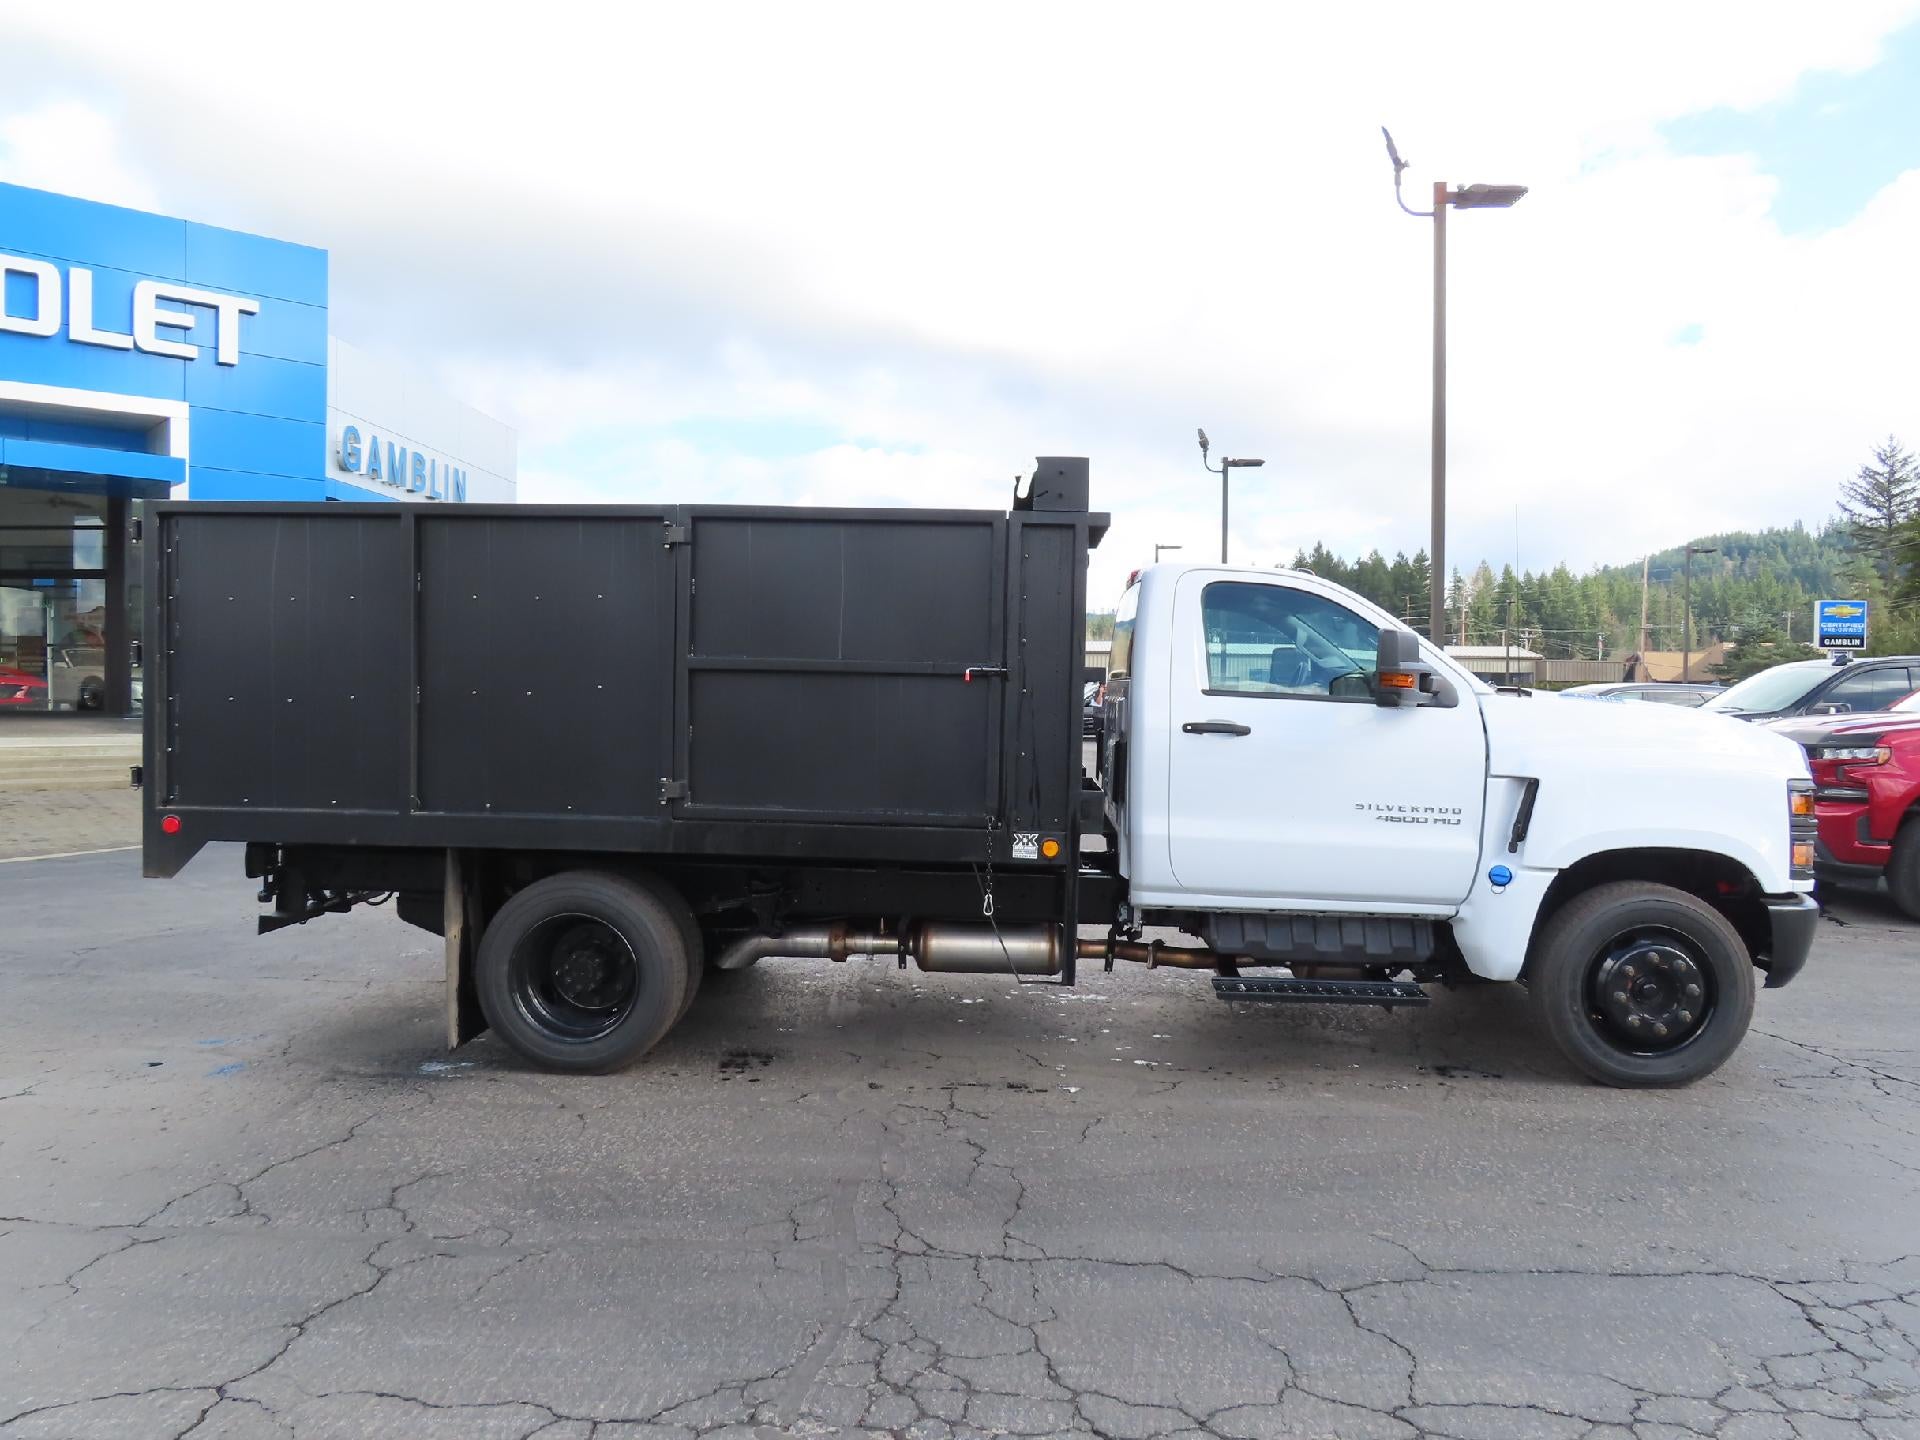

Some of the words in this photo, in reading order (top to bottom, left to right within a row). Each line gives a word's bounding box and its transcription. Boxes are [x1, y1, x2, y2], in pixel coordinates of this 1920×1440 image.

[0, 254, 259, 366] OLET
[341, 425, 466, 502] GAMBLIN
[1824, 638, 1860, 646] GAMBLIN
[1355, 803, 1462, 815] SILVERADO
